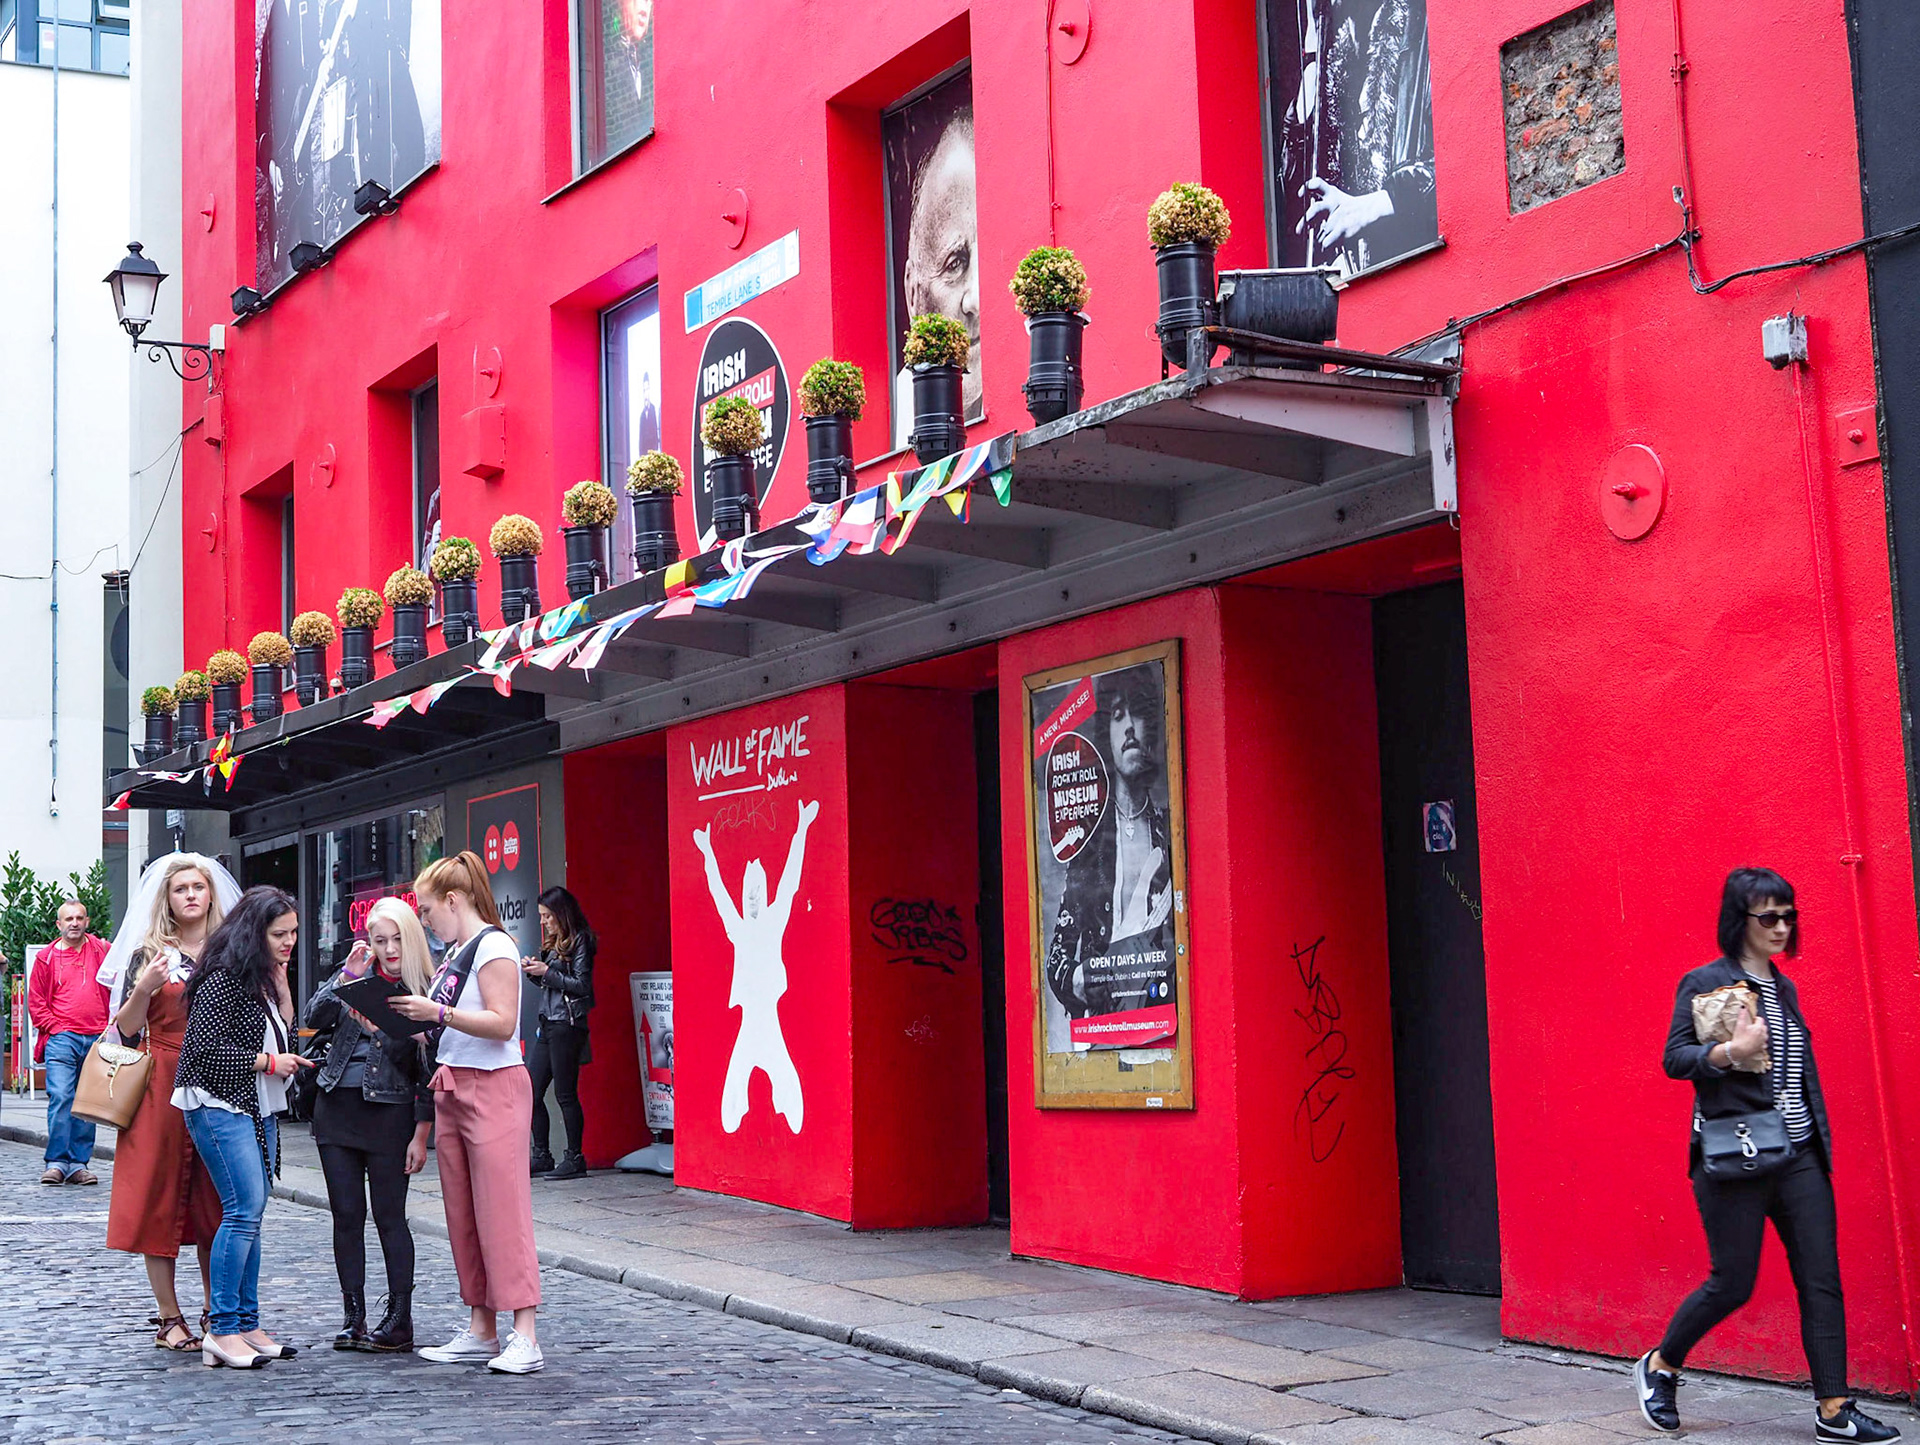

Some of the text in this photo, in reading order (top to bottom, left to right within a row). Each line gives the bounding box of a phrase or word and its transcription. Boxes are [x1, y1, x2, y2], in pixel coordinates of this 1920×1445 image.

[706, 292, 732, 317] TEMPLE
[734, 280, 753, 303] LANE
[703, 348, 746, 397] IRISH
[1039, 736, 1045, 746] A
[1043, 720, 1061, 741] NEW,
[690, 736, 746, 787] WALL
[757, 715, 811, 776] FAME
[1052, 750, 1080, 771] IRISH
[1053, 783, 1099, 808] MUSEUM
[1055, 803, 1099, 823] EXPERIENCE
[1089, 950, 1167, 969] OPEN 7 DAYS A WEEK
